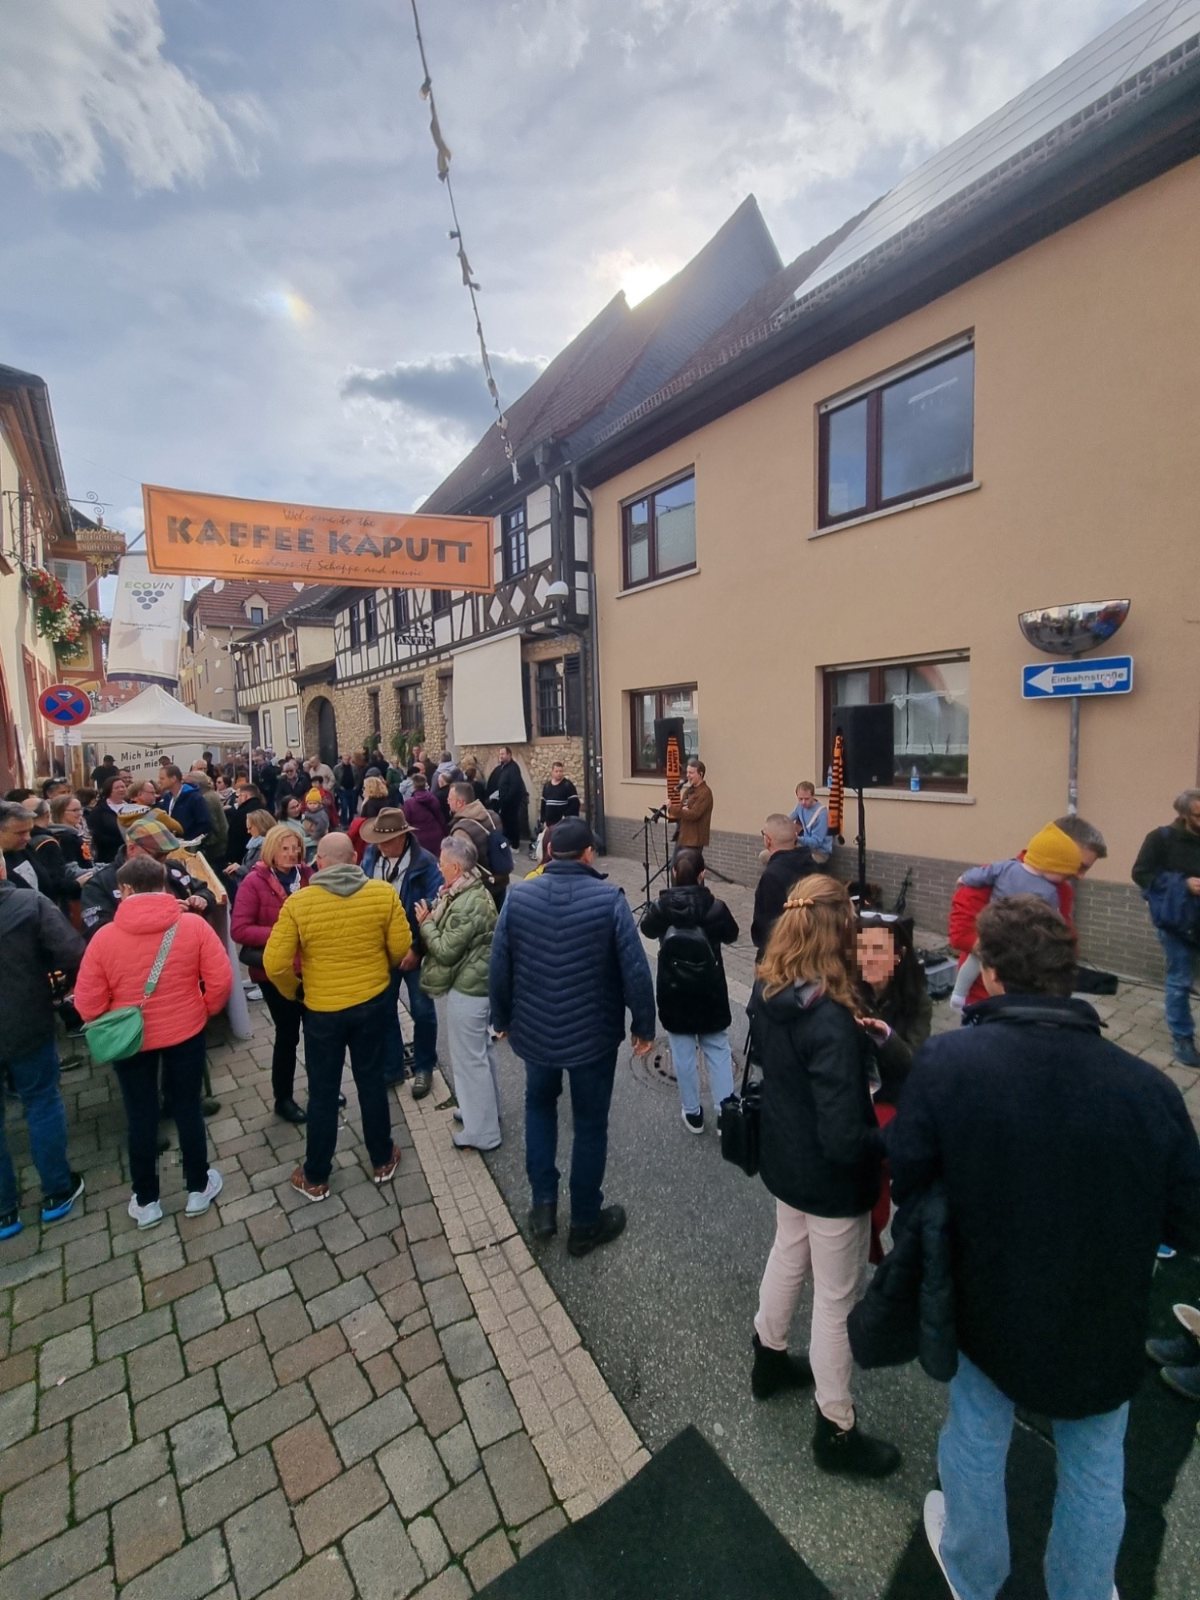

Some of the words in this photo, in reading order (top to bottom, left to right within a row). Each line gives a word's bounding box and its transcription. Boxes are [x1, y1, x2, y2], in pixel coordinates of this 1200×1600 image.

[167, 515, 315, 553] KAFFEE
[328, 530, 472, 563] KAPUTT
[363, 565, 386, 574] and
[125, 581, 175, 590] ECOVIN
[397, 636, 432, 645] ANTIK
[121, 751, 142, 761] Mich
[145, 749, 163, 757] kann
